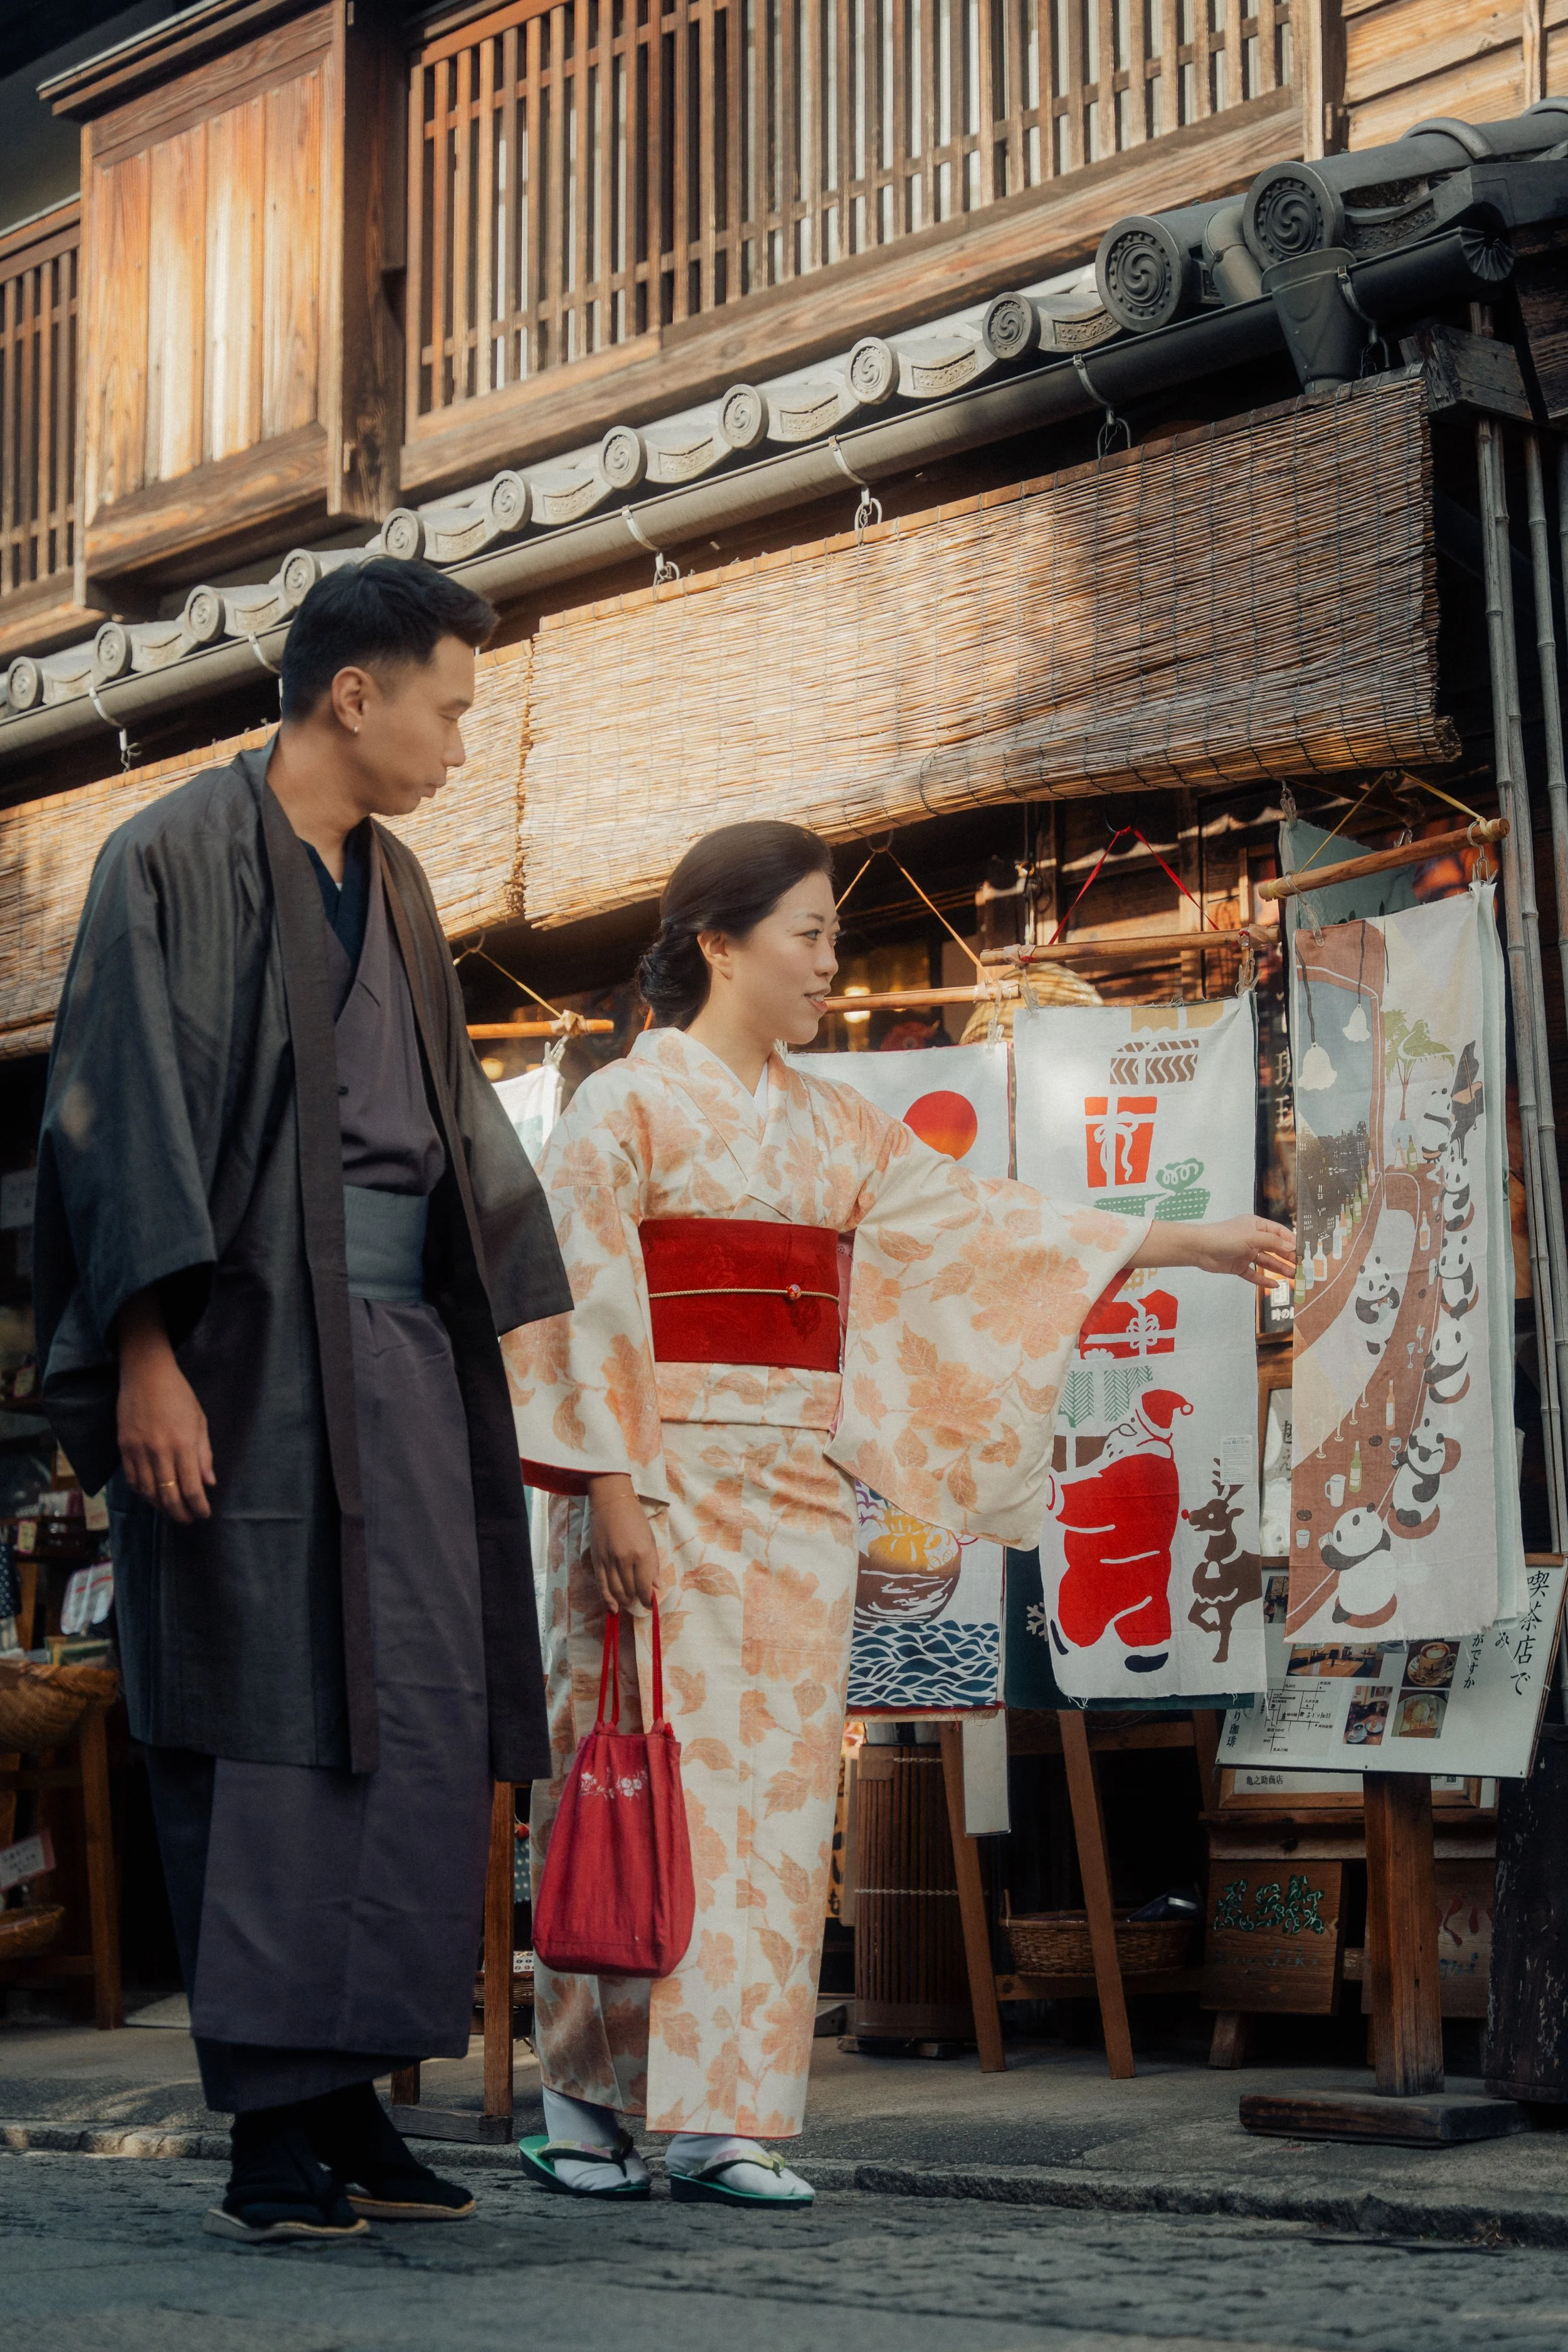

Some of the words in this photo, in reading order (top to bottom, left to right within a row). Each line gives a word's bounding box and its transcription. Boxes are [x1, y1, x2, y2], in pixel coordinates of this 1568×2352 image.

[1271, 1306, 1295, 1321] 時の
[1510, 1570, 1550, 1696] 喫茶店で
[1246, 1774, 1283, 1786] 亀之助商店
